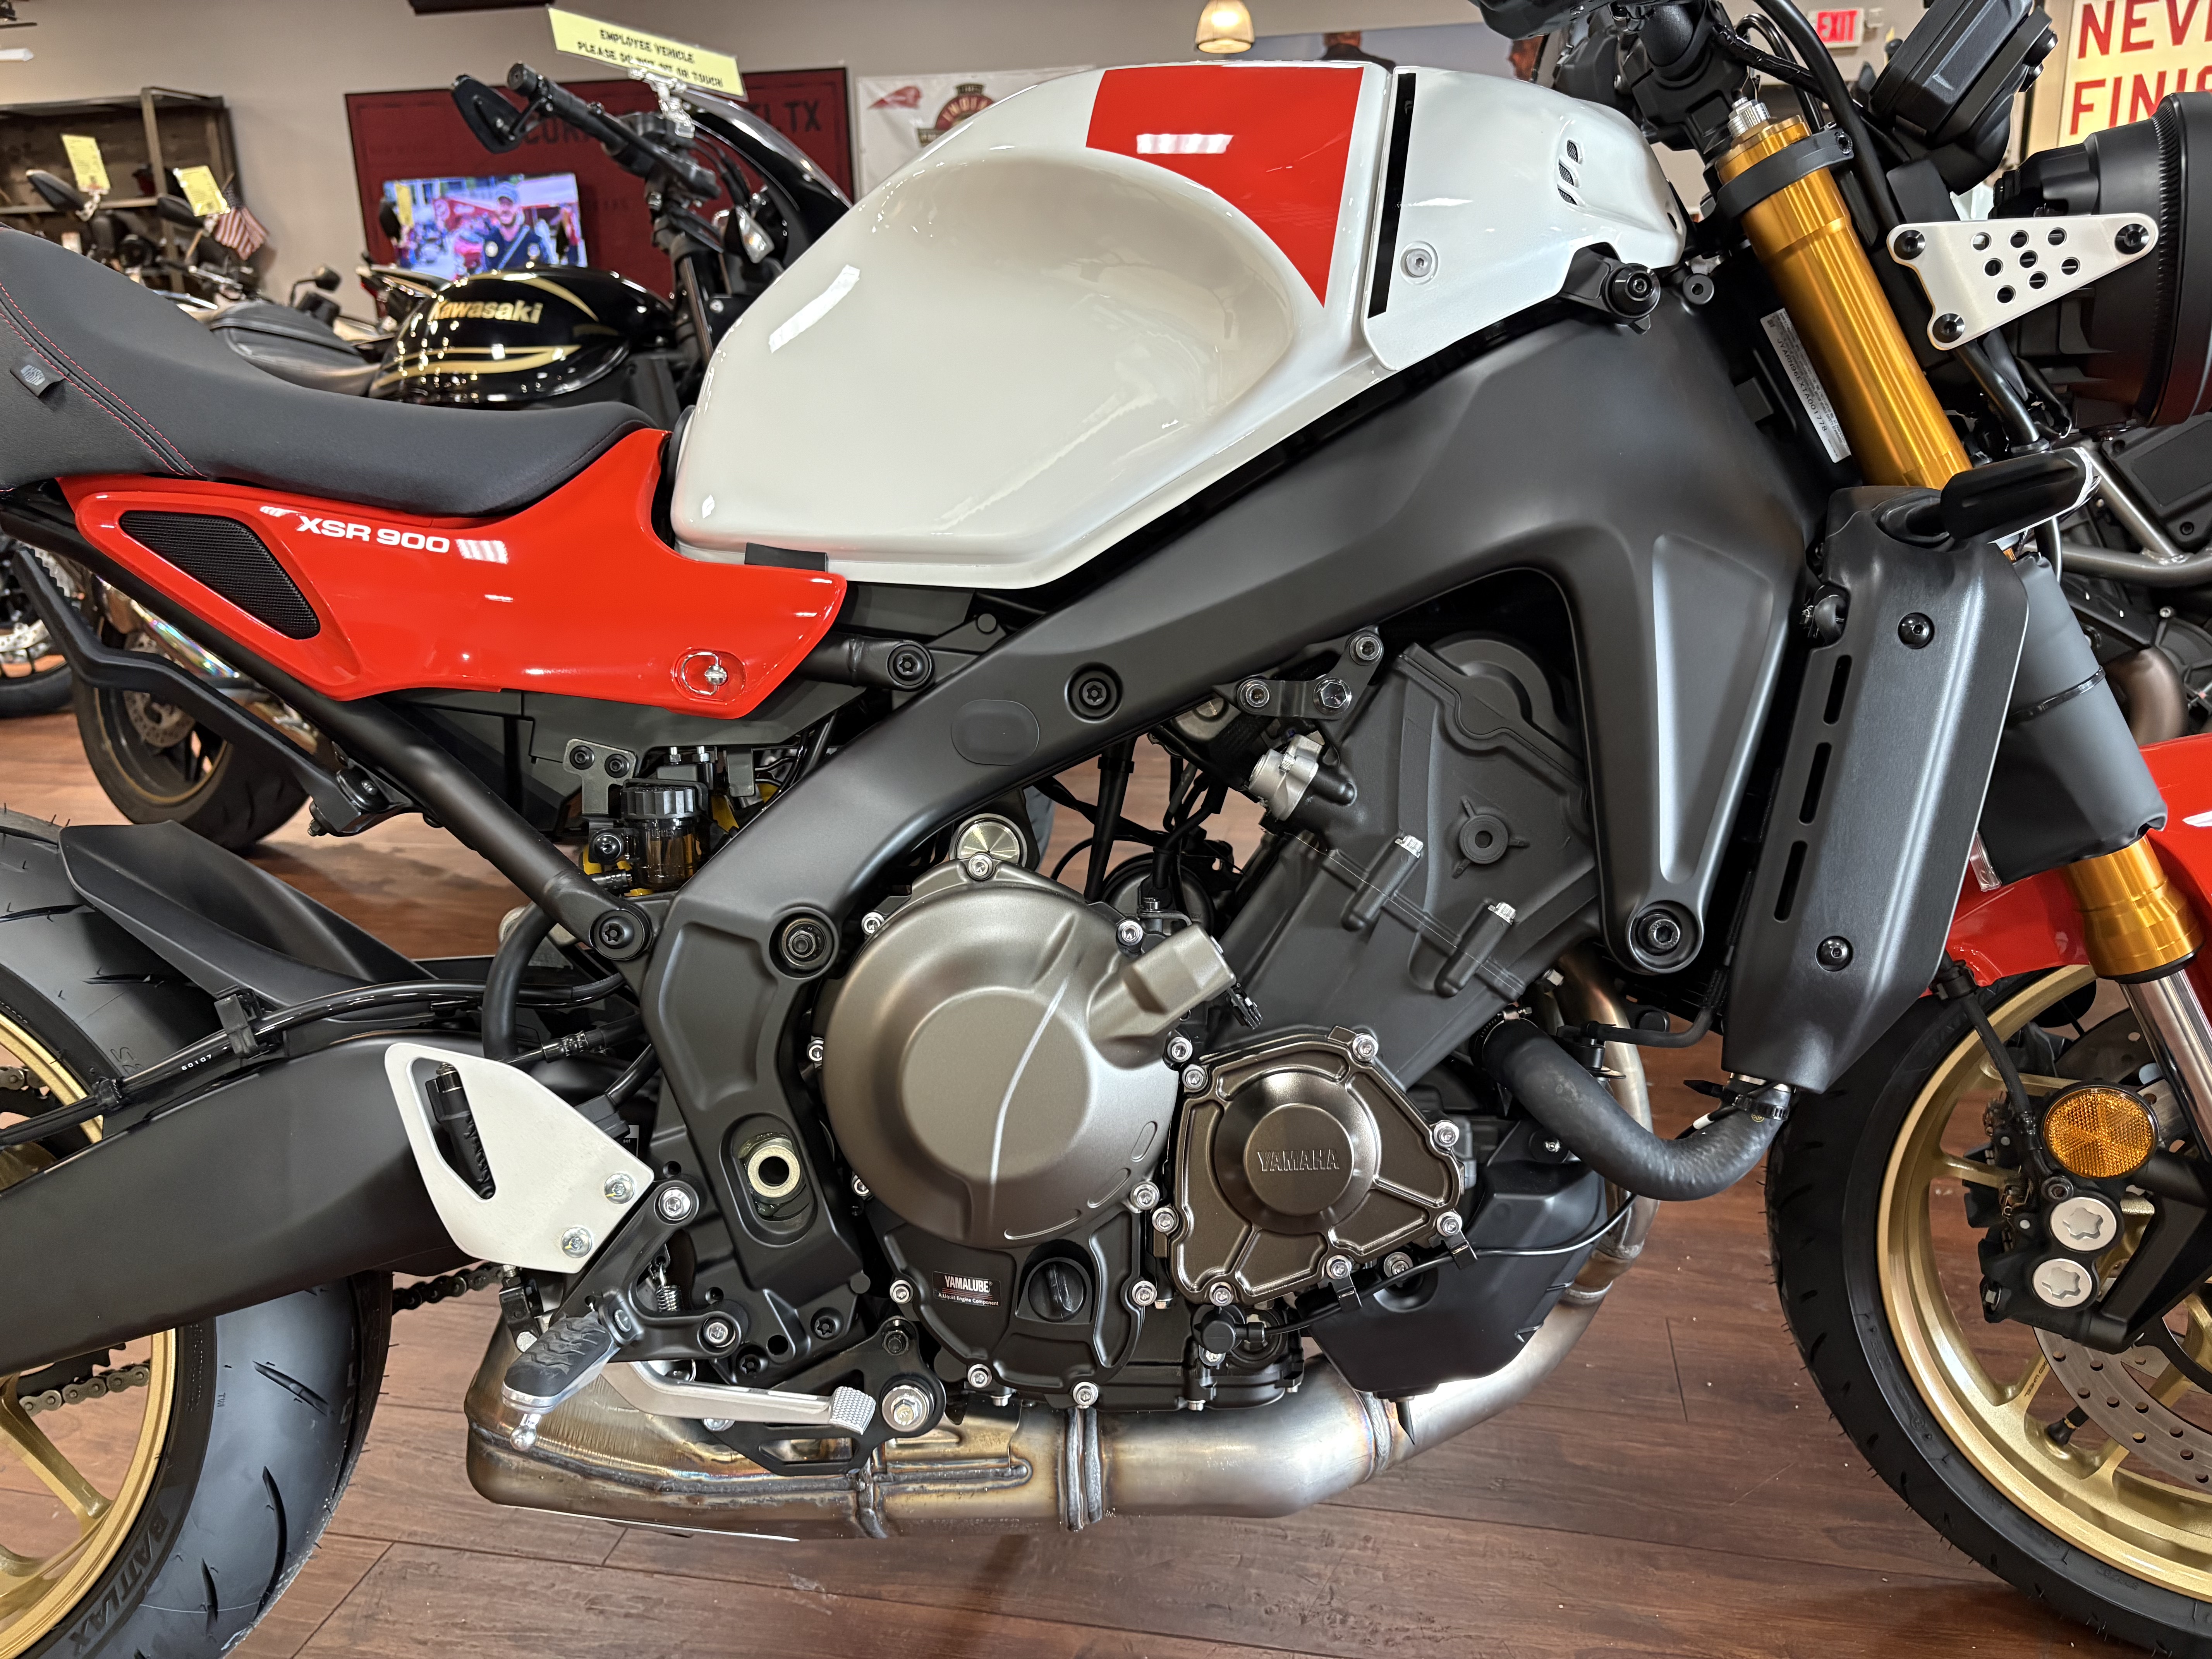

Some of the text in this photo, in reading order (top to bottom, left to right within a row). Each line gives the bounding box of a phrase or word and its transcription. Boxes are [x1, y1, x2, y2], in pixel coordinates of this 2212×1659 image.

[1817, 10, 1858, 42] EXIT
[577, 41, 616, 61] PLEASE
[599, 29, 695, 64] EMPLOYEE VEHICLE
[783, 98, 822, 133] TX
[942, 96, 988, 122] INDIA
[428, 299, 543, 324] Kawasaki
[297, 517, 450, 553] XSR 900
[180, 1054, 213, 1072] 60107
[1257, 1149, 1340, 1172] YAMAHA
[944, 1275, 990, 1293] YAMALUBE
[972, 1298, 999, 1306] Component
[69, 1506, 172, 1658] BATTLAX
